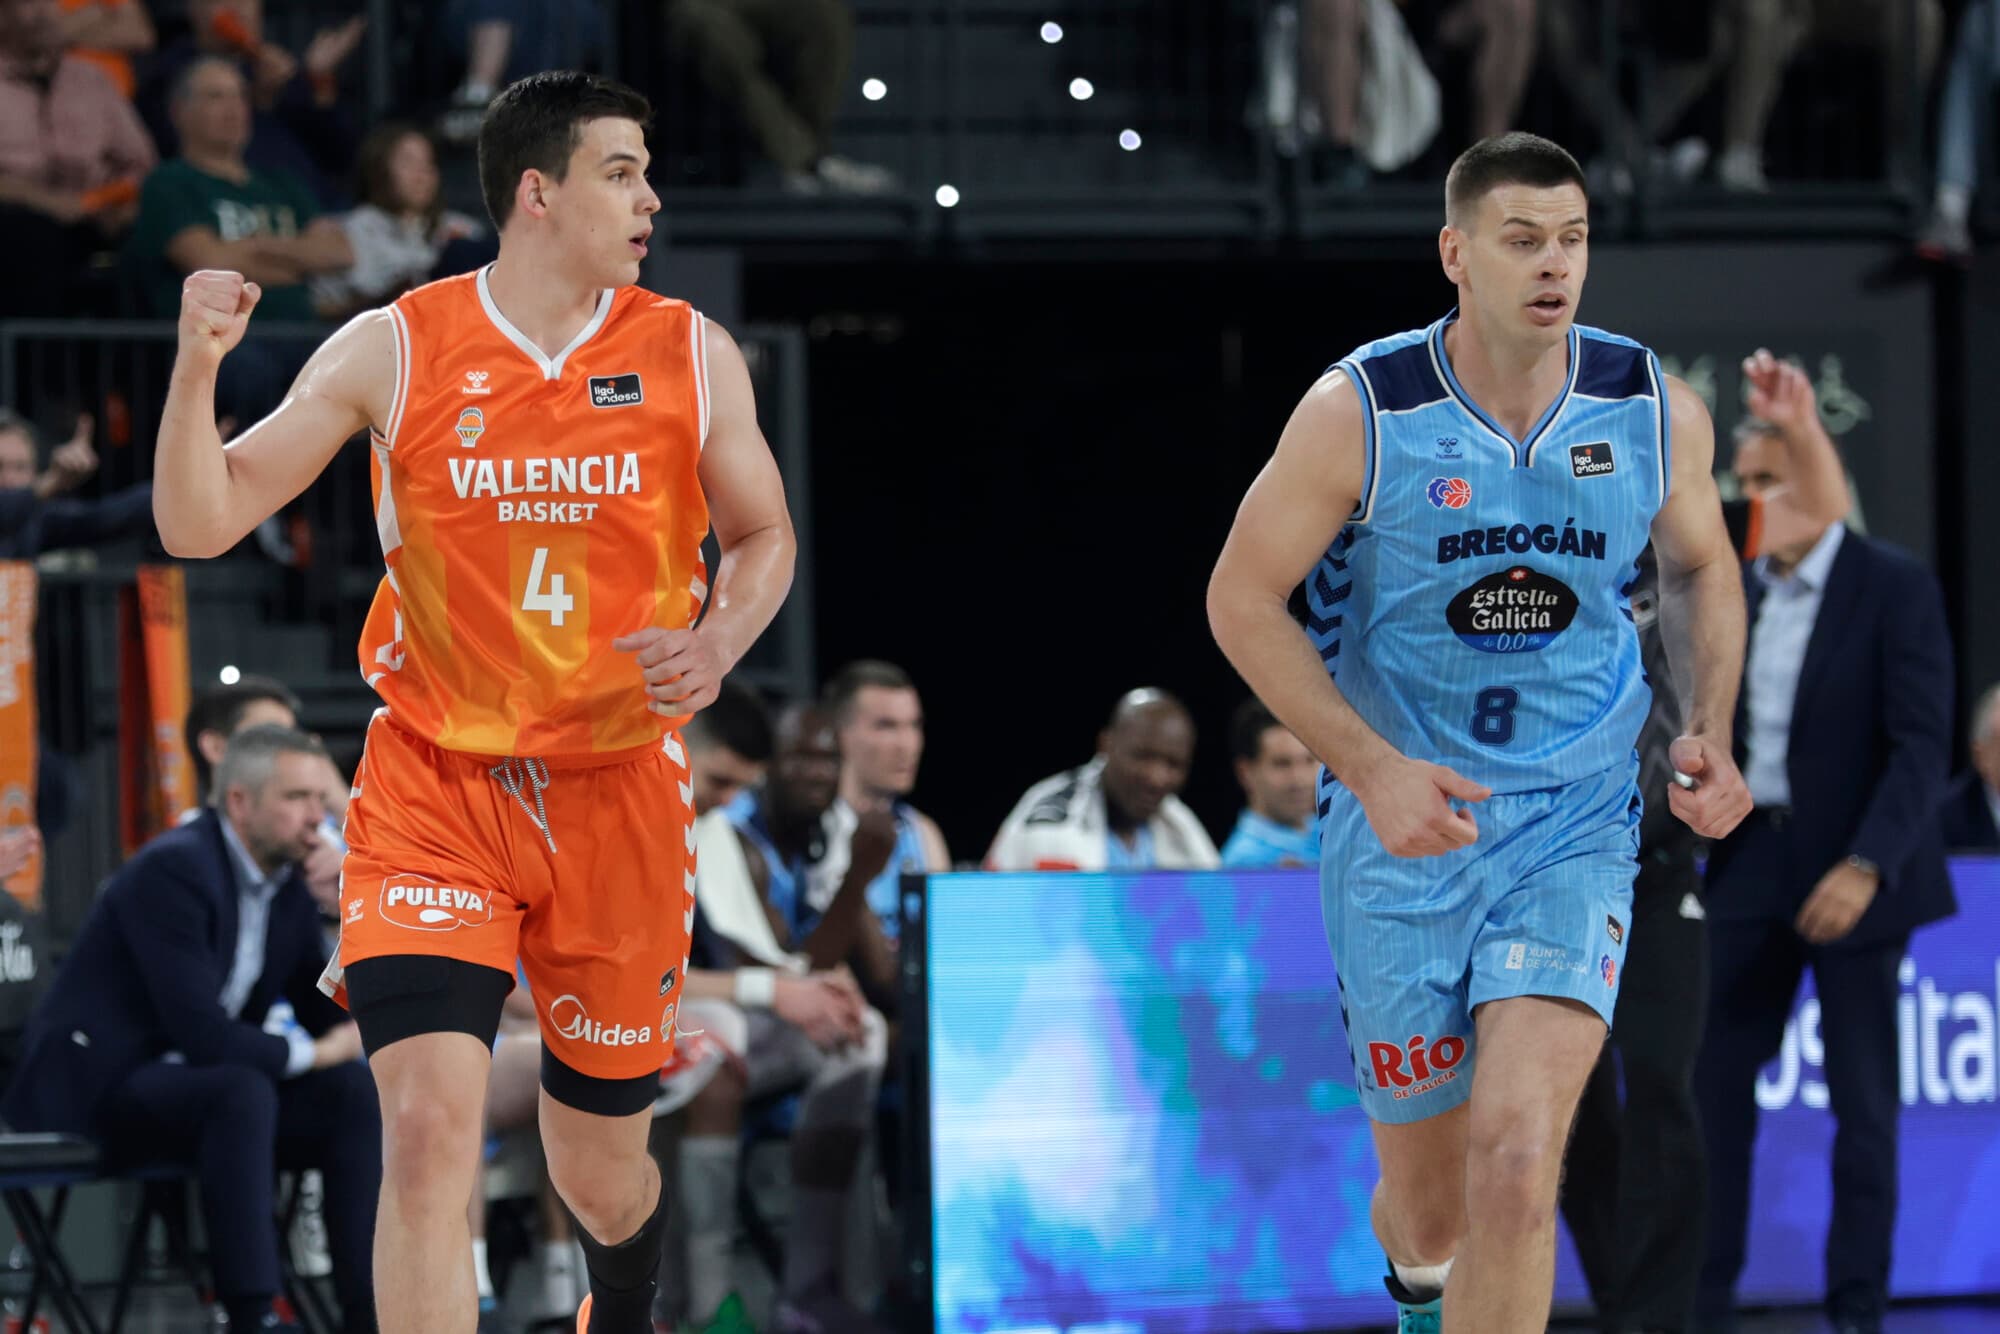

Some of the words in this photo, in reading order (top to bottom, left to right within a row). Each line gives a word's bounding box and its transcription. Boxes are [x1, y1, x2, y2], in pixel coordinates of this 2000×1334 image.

[594, 386, 615, 397] liga
[595, 391, 639, 404] endesa
[1574, 454, 1592, 465] liga
[1576, 461, 1612, 474] endesa
[448, 453, 641, 498] VALENCIA
[498, 501, 598, 522] BASKET
[1437, 517, 1606, 564] BREOGÁN
[521, 547, 574, 627] 4
[1469, 585, 1559, 609] Estrella
[1472, 607, 1551, 630] Galicia
[1469, 686, 1520, 747] 8
[387, 886, 484, 912] PULEVA
[550, 994, 651, 1046] Midea
[1393, 1089, 1410, 1099] DE
[1412, 1071, 1457, 1095] GALICIA
